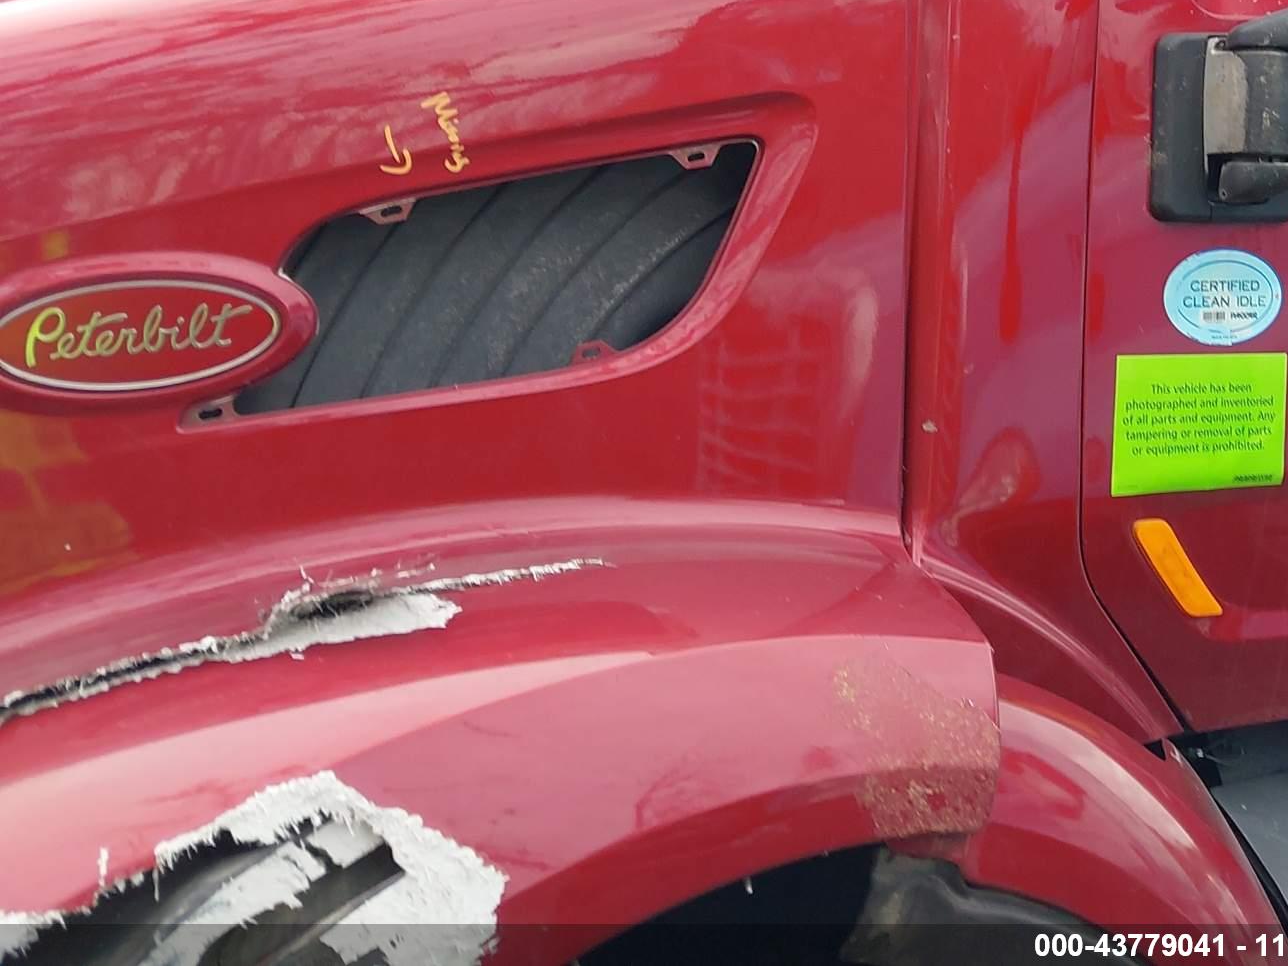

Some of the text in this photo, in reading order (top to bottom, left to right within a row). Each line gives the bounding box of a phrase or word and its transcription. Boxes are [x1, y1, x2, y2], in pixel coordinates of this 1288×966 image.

[1190, 280, 1260, 293] CERTIFIED
[1183, 295, 1266, 308] CLEAN IDLE
[25, 303, 252, 368] Peterbilt
[1151, 382, 1252, 395] This vehicle has been
[1125, 395, 1274, 413] photographed and inventoried
[1122, 411, 1276, 428] of all parts and equipment. Any
[1126, 425, 1272, 442] tampering or removal of parts
[1132, 439, 1265, 457] or equipment is prohibited.
